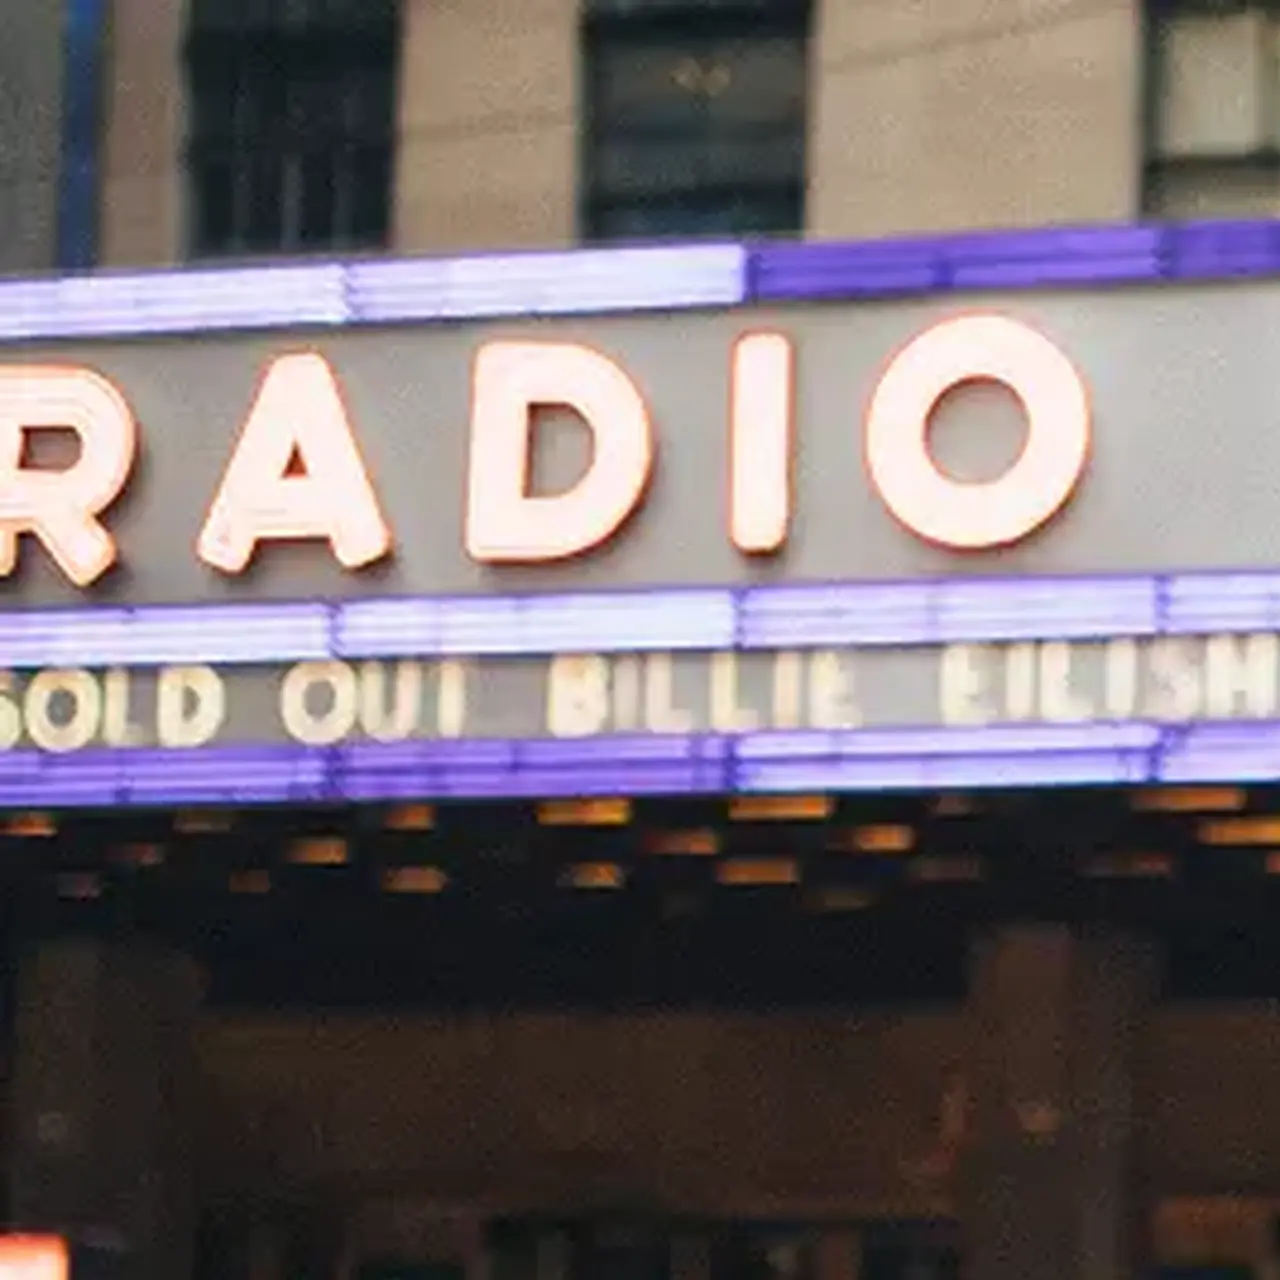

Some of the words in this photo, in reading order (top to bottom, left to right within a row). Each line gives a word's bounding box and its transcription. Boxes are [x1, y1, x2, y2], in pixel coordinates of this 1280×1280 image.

[0, 309, 1095, 590] RADIO
[281, 654, 467, 746] OUT
[548, 645, 862, 740] BILLIE
[937, 634, 1280, 727] EILISH
